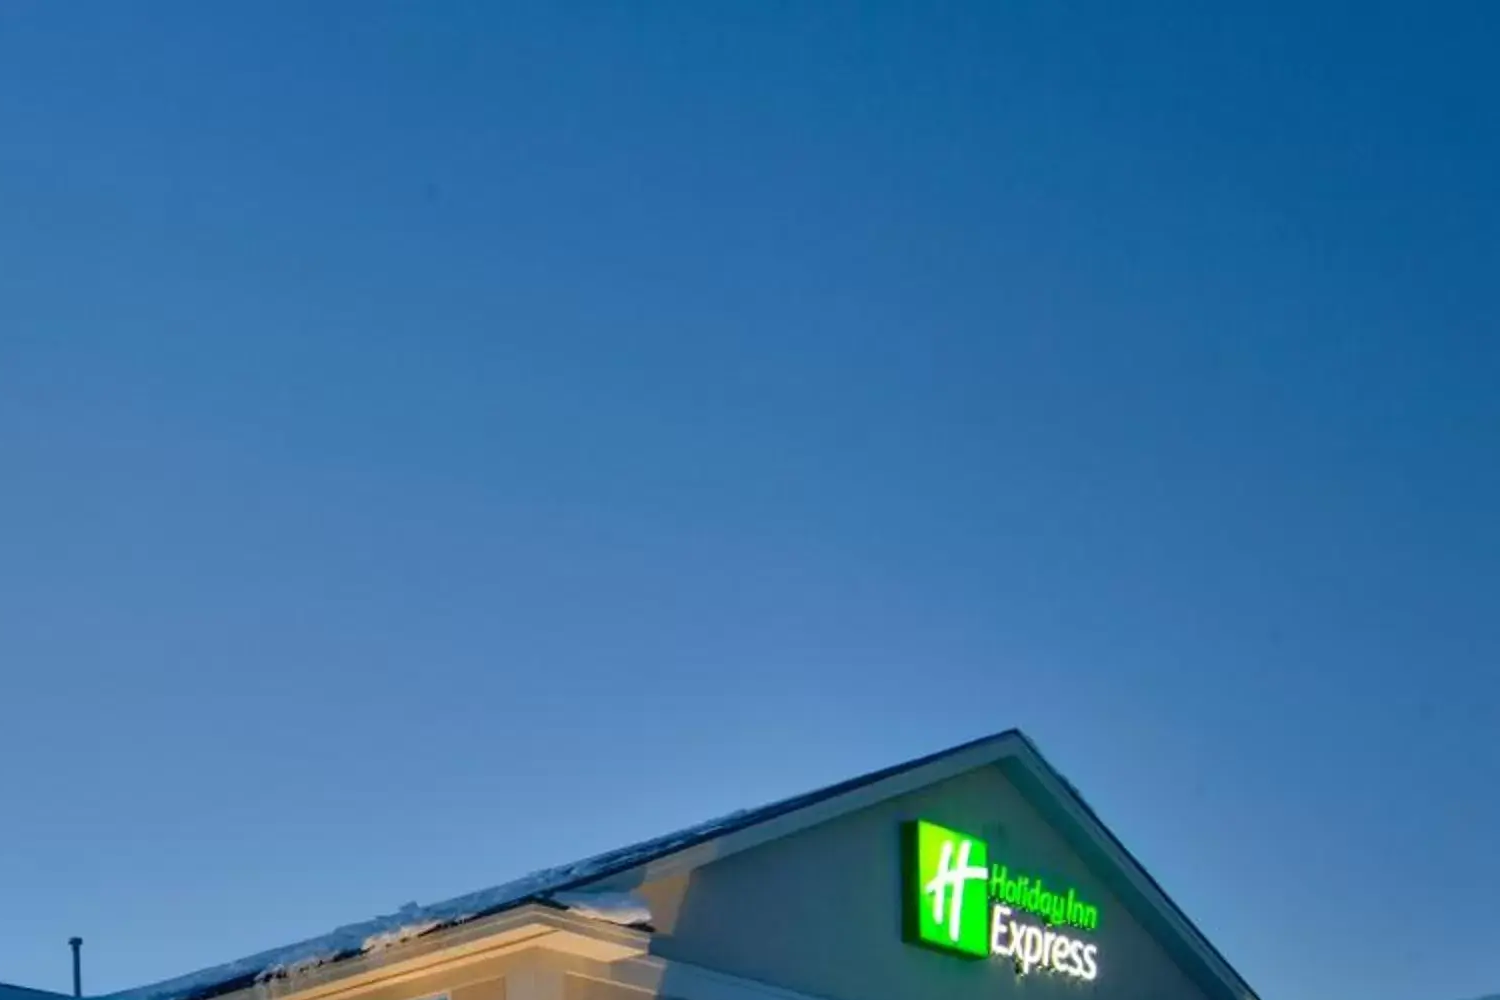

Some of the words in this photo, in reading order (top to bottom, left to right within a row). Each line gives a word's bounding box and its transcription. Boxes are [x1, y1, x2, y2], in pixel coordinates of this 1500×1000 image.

[926, 839, 989, 943] H
[991, 863, 1066, 925] Holiday
[1067, 888, 1098, 928] Inn
[991, 904, 1098, 980] Express
